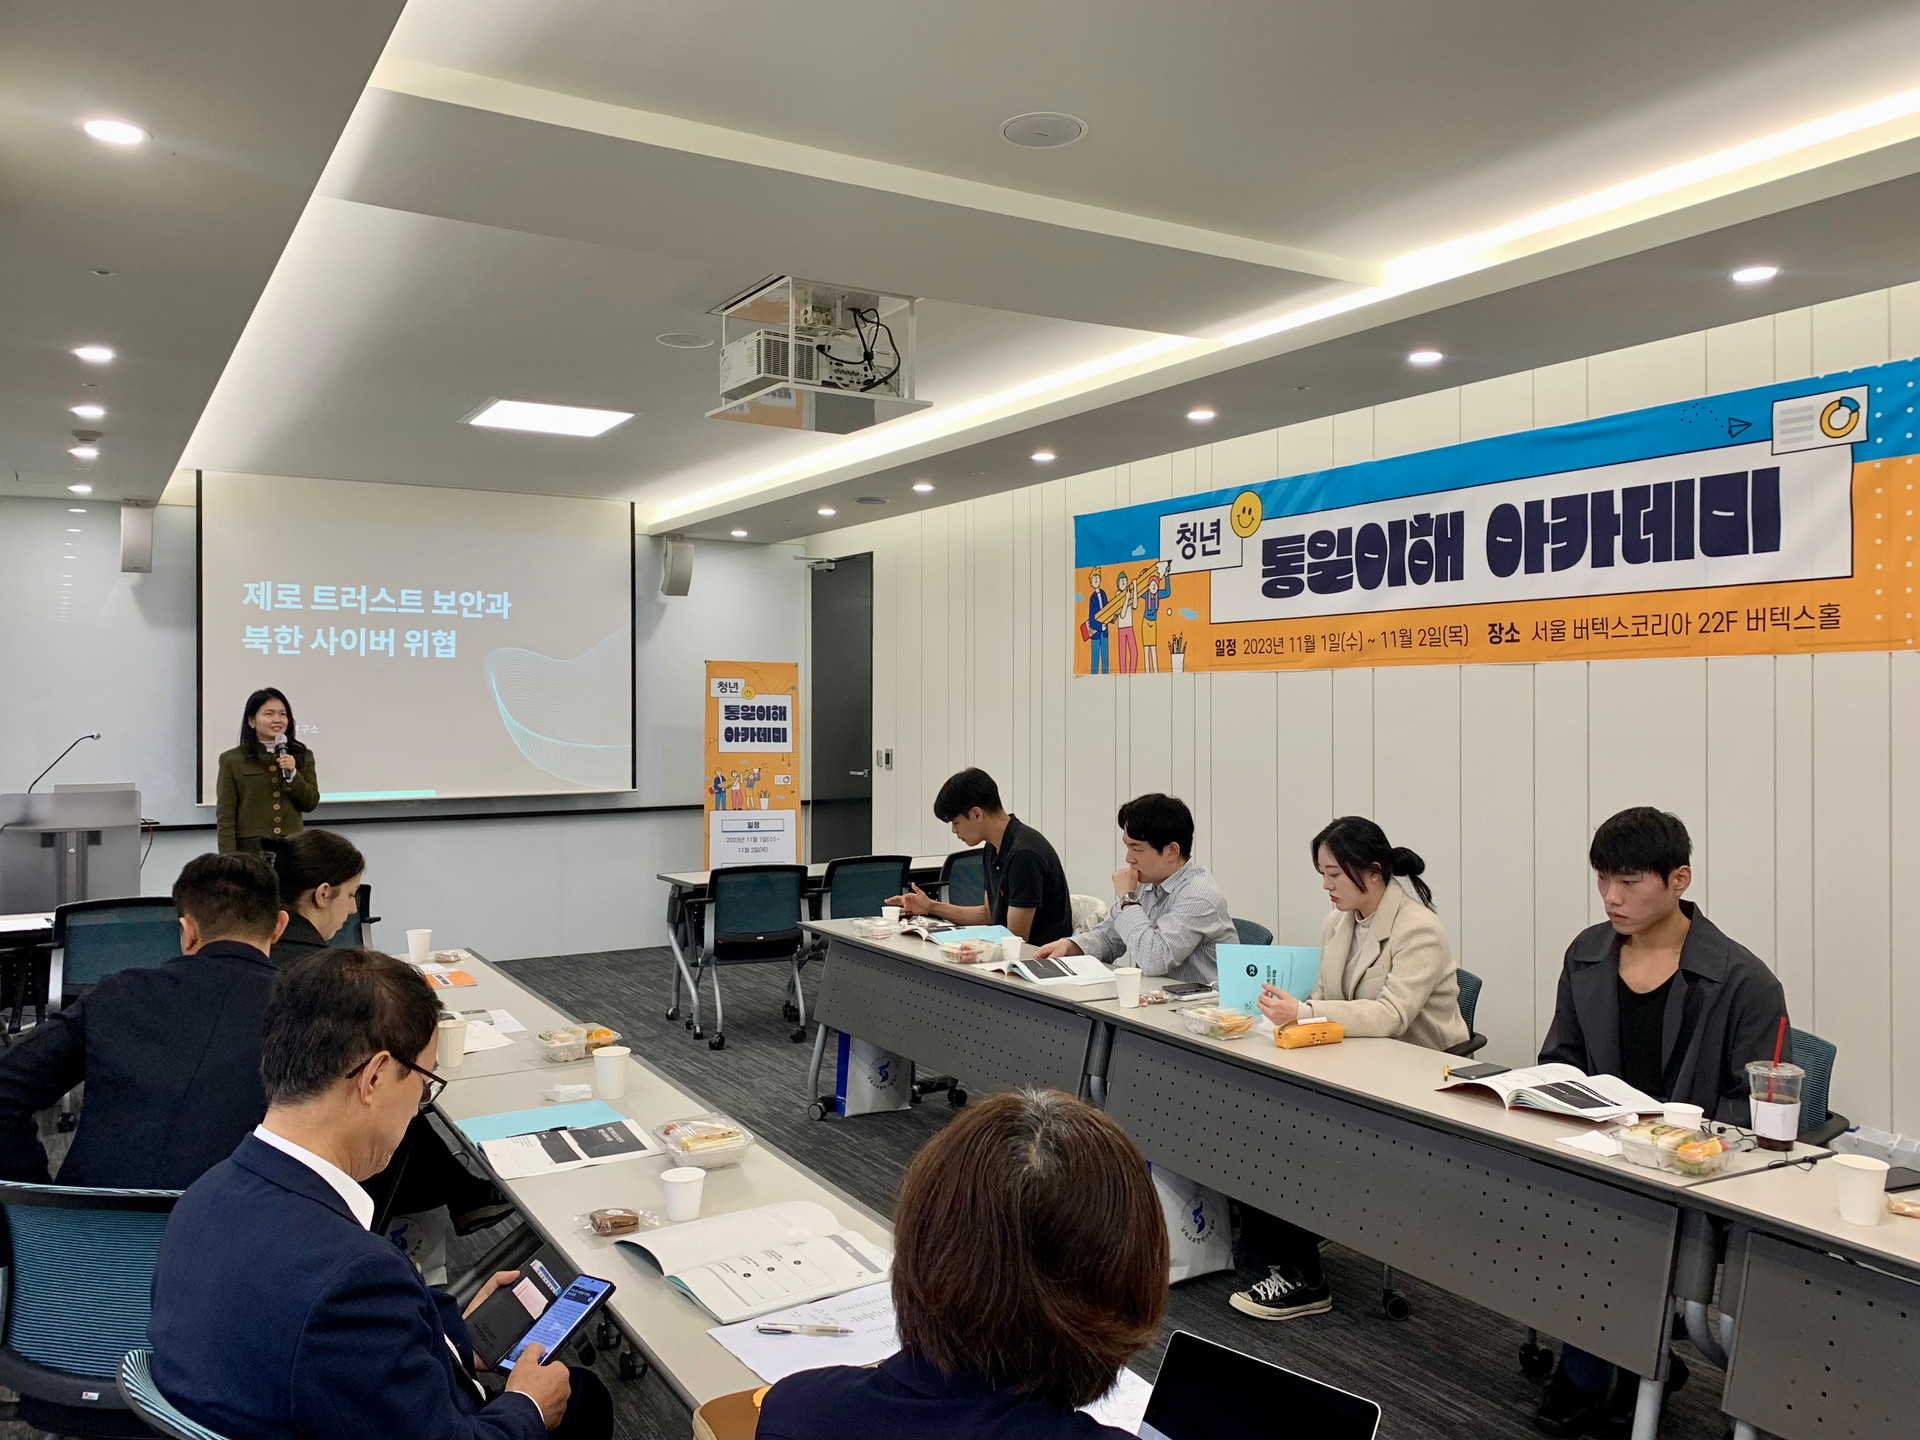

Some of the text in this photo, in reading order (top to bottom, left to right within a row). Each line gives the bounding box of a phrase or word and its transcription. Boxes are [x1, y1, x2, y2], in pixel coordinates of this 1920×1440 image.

[1175, 517, 1222, 561] 청년
[1261, 466, 1781, 599] 통일이해 아카데미
[242, 581, 512, 620] 제로 트러스트 보안과
[1214, 638, 1237, 657] 일정
[1243, 636, 1284, 655] 2023년
[1289, 634, 1316, 653] 11월
[1321, 630, 1363, 652] 1일(수)
[1381, 627, 1413, 649] 11월
[1418, 624, 1470, 649] 2일(목)
[1487, 603, 1842, 645] 장소 서울 버텍스코리아 22F 버텍스홀
[242, 625, 457, 658] 북한 사이버 위협
[717, 681, 739, 694] 청년
[724, 705, 787, 721] 통일이해
[724, 726, 787, 743] 아카데미
